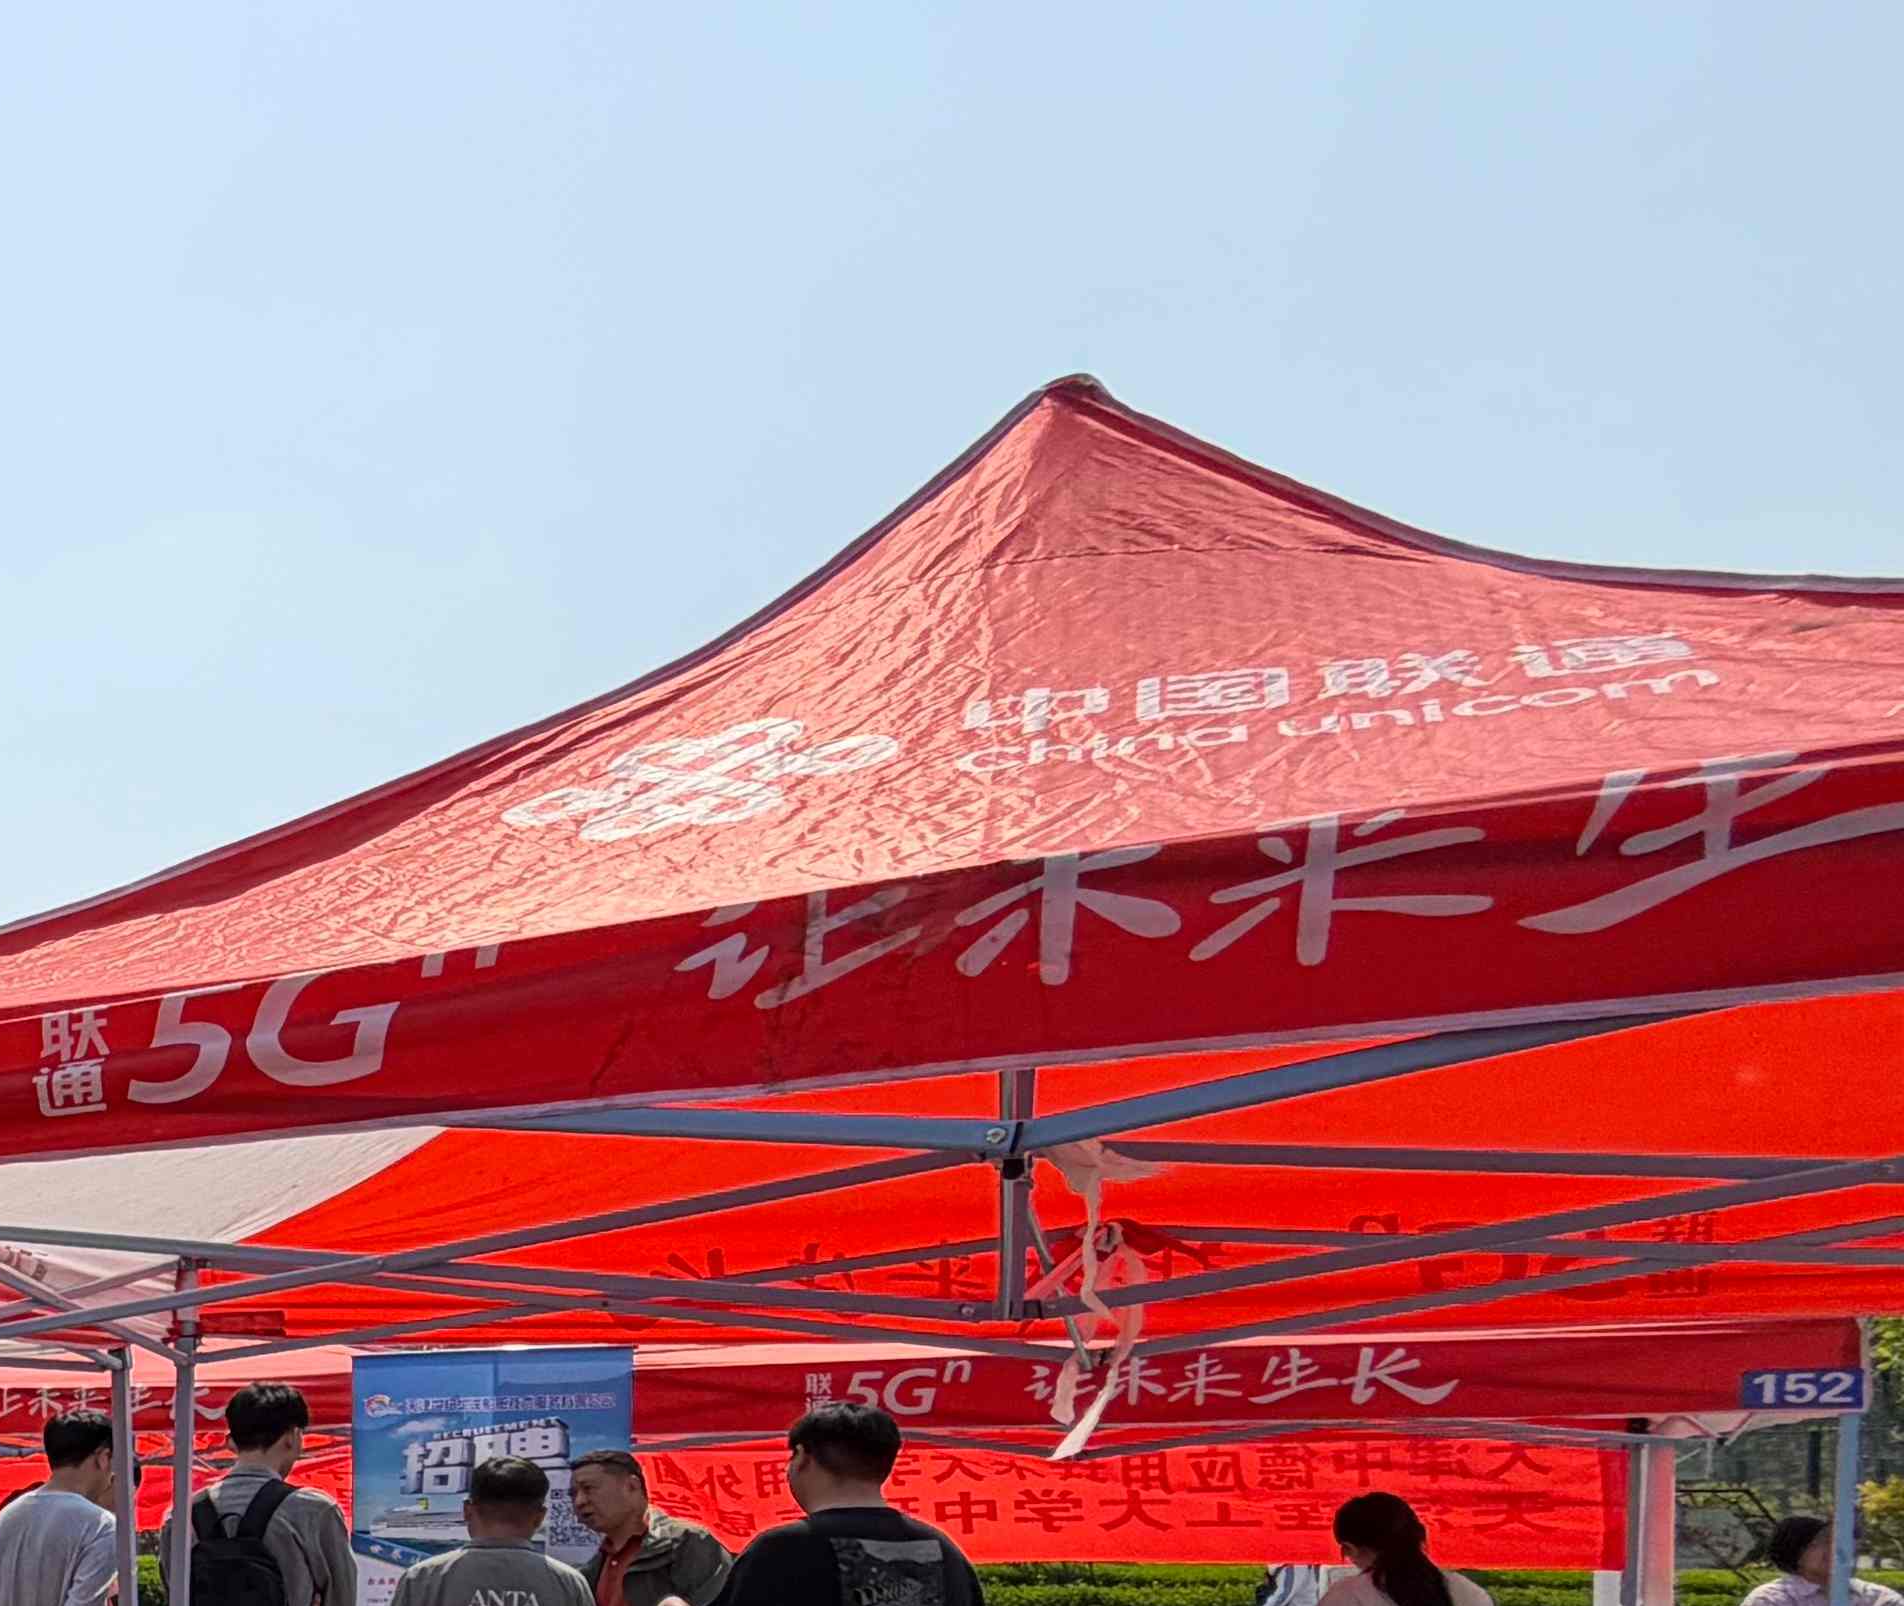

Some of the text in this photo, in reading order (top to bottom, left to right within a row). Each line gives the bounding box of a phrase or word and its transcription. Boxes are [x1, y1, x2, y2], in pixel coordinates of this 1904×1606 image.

[961, 630, 1696, 733] 中国联通
[1277, 667, 1721, 738] unicom
[33, 1002, 109, 1118] 联通
[1752, 1371, 1853, 1404] 152
